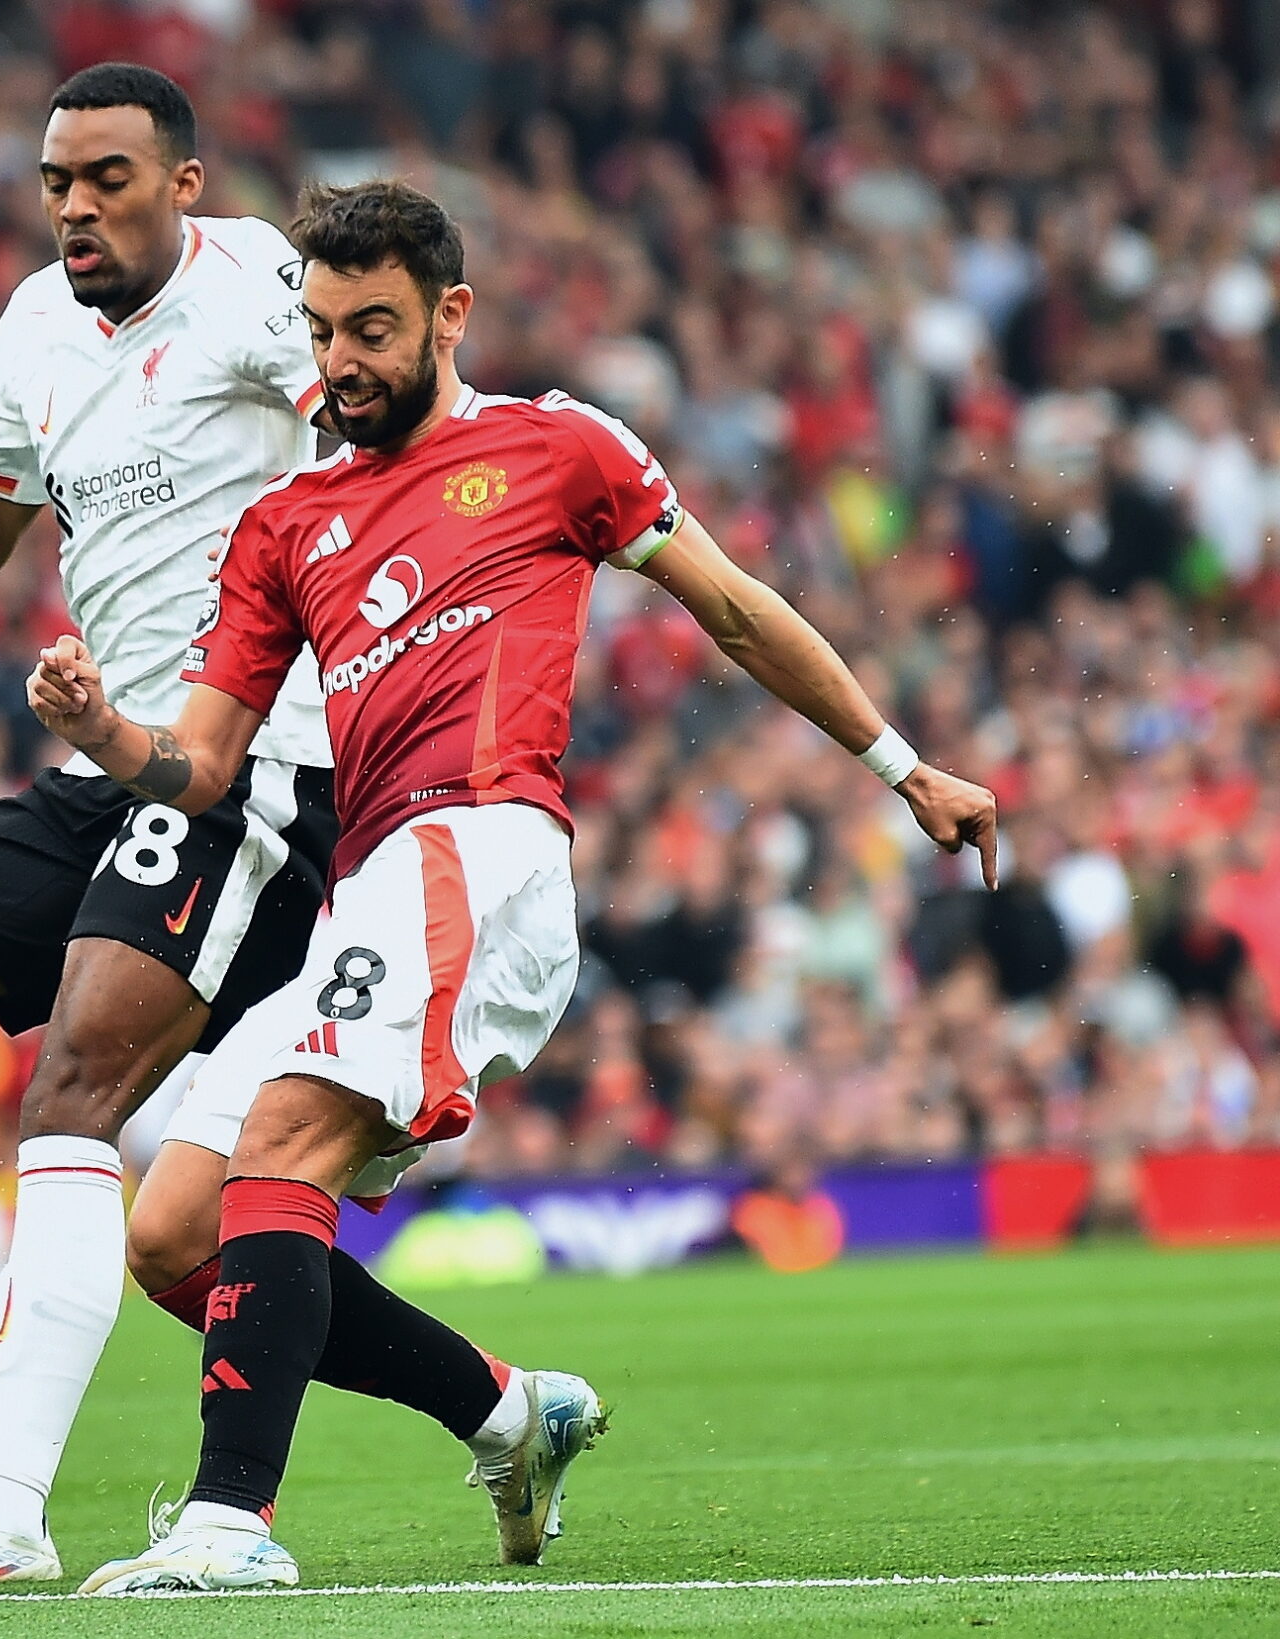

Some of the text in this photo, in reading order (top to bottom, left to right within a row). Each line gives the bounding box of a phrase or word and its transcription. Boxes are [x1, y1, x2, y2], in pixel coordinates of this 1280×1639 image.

[72, 455, 162, 501] standard
[80, 478, 176, 523] chartered
[317, 946, 386, 1020] 8
